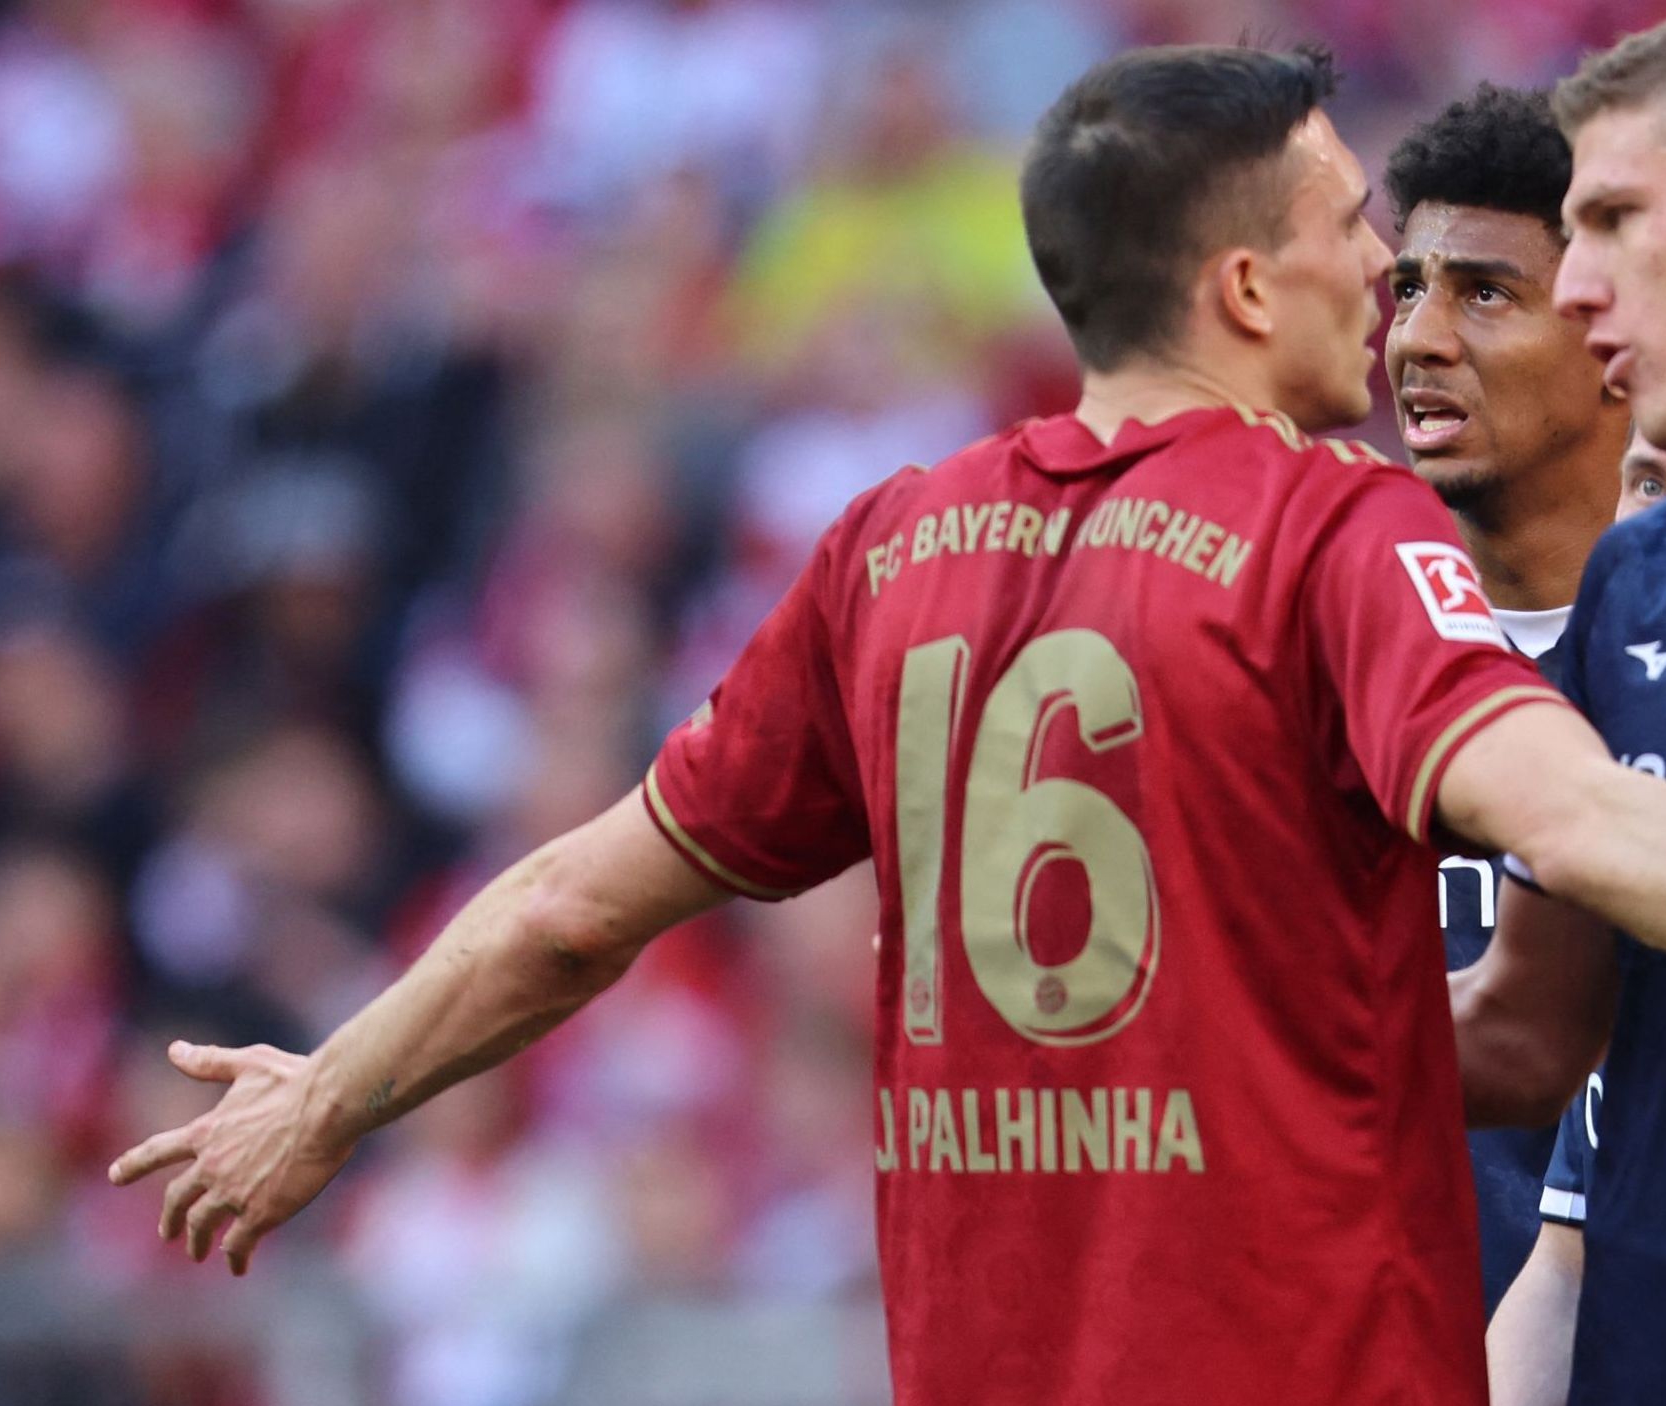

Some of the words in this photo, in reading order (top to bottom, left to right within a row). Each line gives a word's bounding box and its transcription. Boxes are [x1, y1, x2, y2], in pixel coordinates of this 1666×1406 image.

[865, 533, 904, 598] FC
[896, 627, 1161, 1047] 16
[908, 1087, 1206, 1173] PALHINHA
